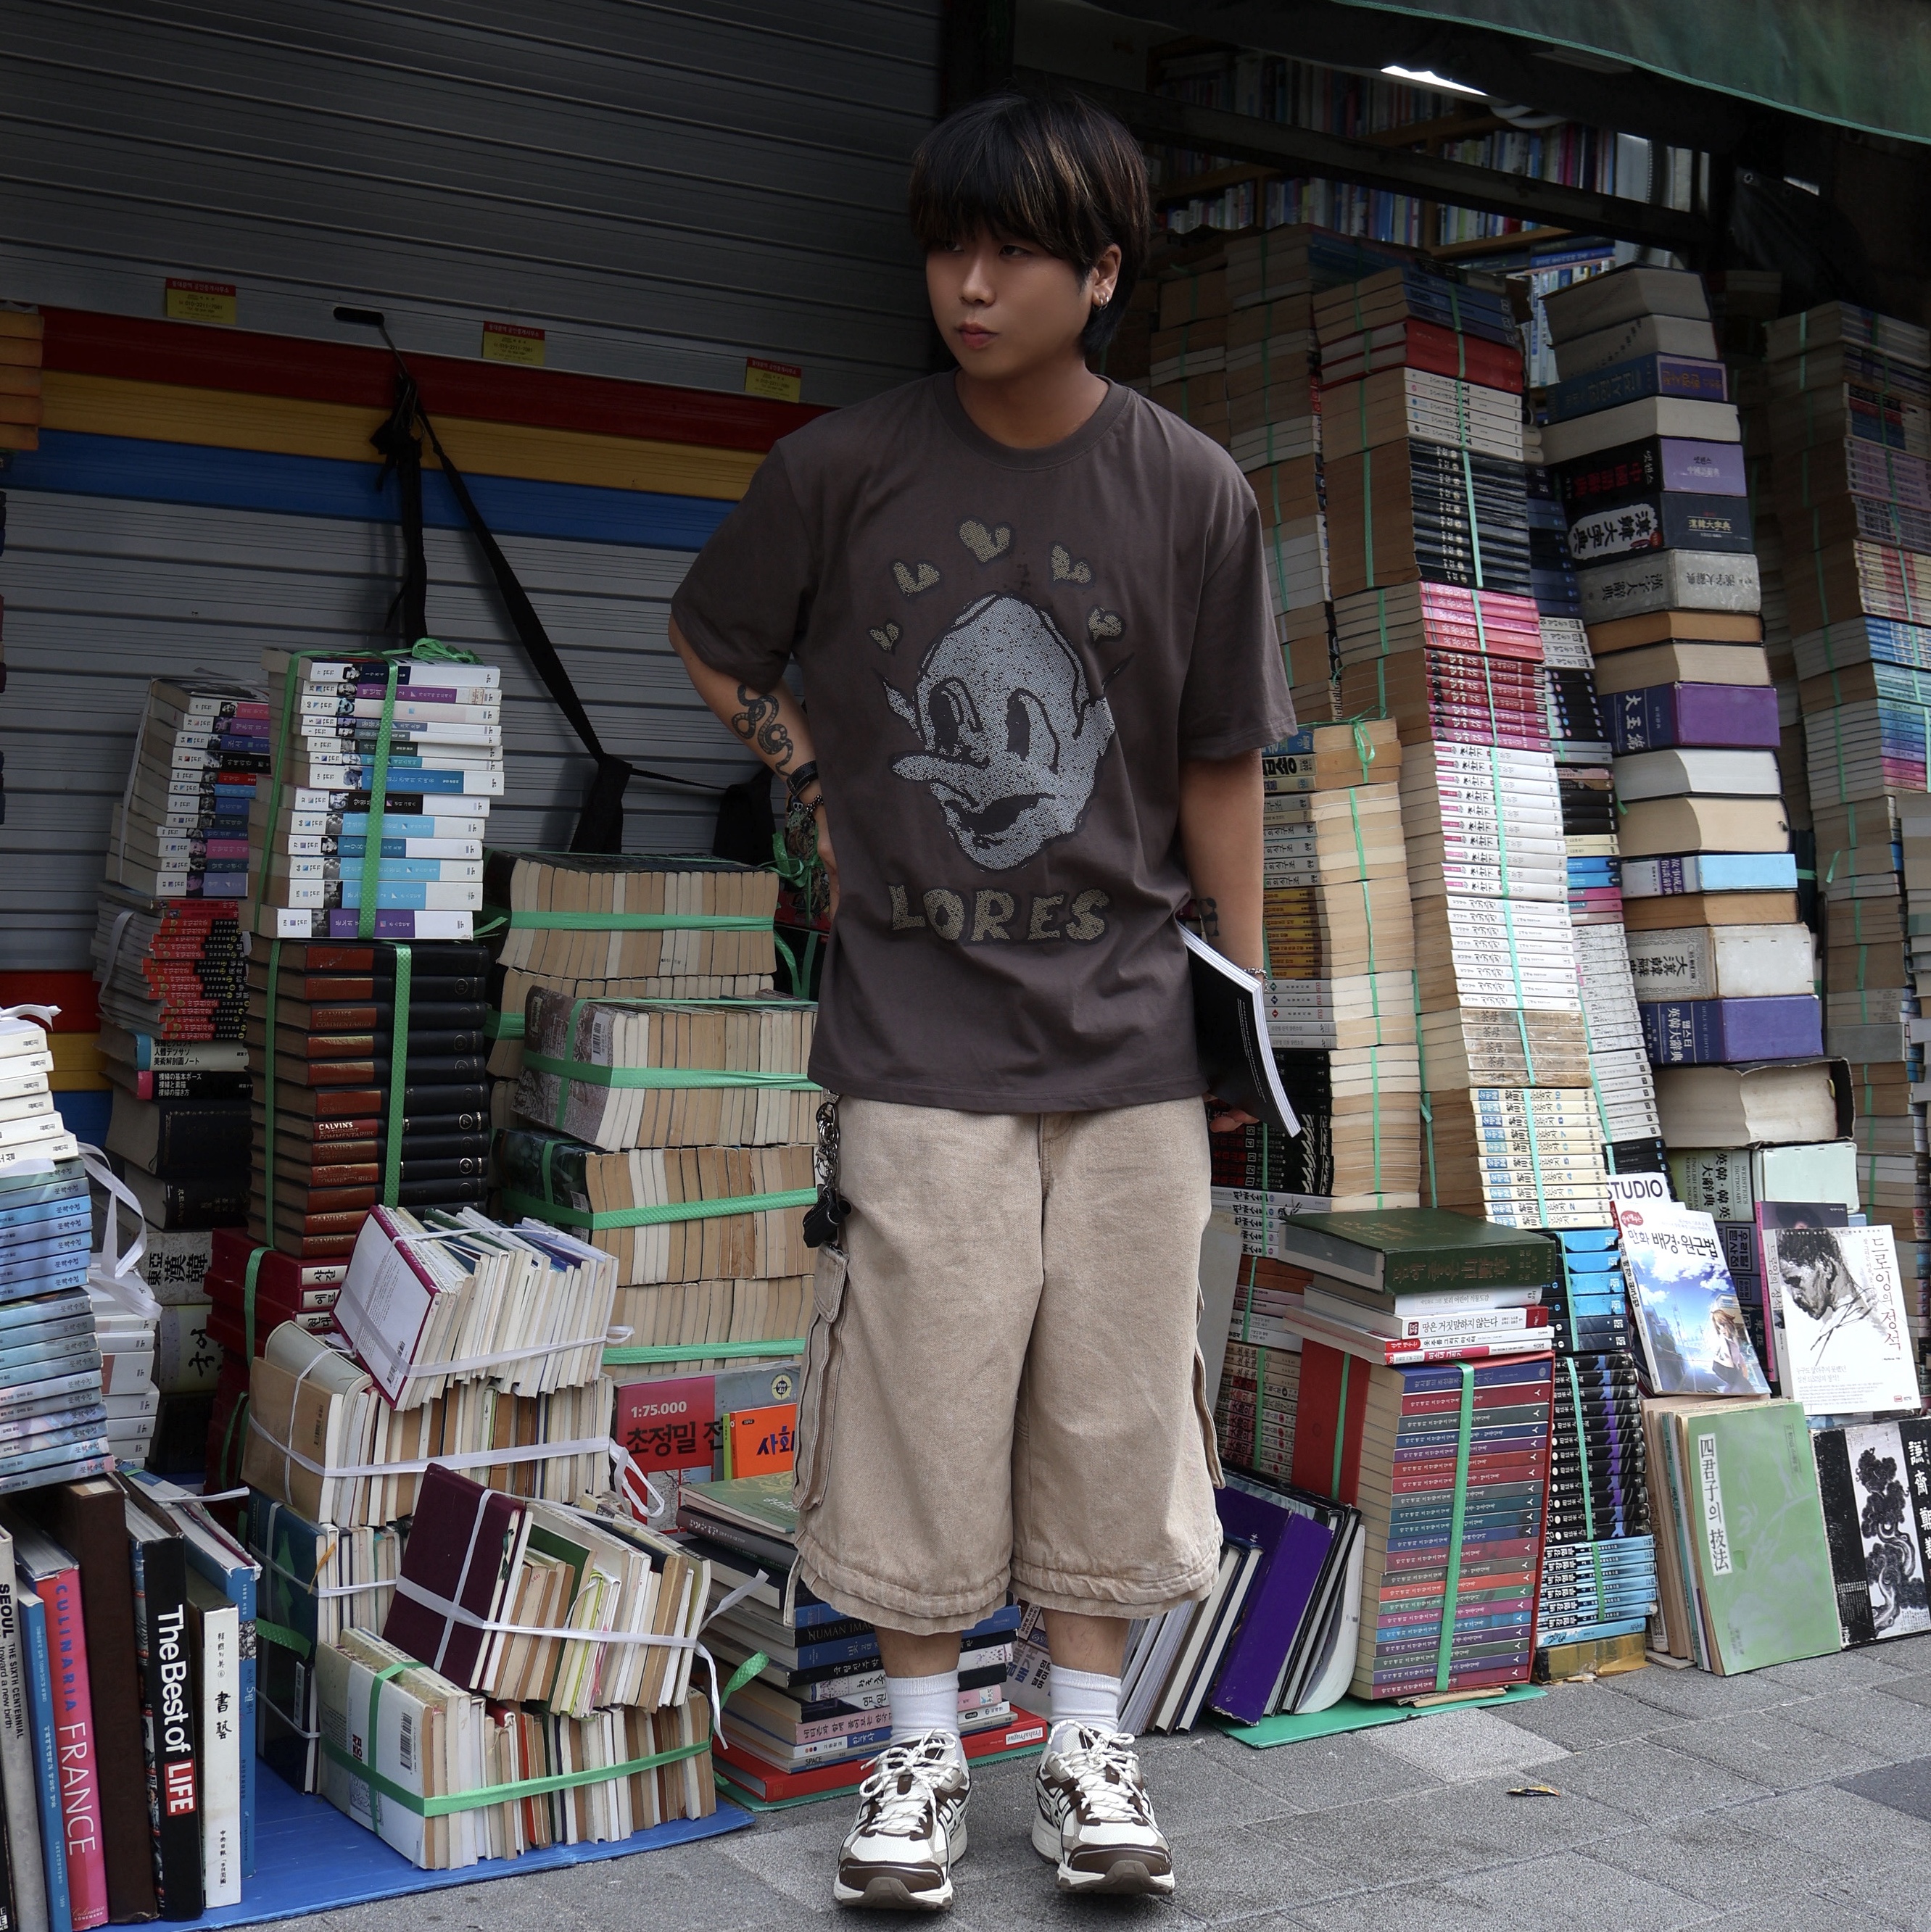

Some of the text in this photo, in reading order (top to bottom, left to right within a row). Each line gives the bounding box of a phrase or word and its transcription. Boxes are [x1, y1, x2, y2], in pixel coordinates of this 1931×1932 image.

[318, 1121, 353, 1131] CALVIN'S
[318, 1131, 374, 1140] COMMENTARIES
[1628, 1229, 1650, 1245] 만화
[1872, 1237, 1901, 1351] 드로잉의 정석
[1422, 1316, 1498, 1334] 땅은 거짓말하지 않는다
[627, 1421, 697, 1456] 초정밀
[1700, 1438, 1729, 1572] 四君子의 技法
[0, 1583, 15, 1638] SEOUL
[56, 1585, 76, 1712] CULINARIA
[9, 1660, 20, 1685] SIXTH
[158, 1604, 191, 1754] The Best of
[4, 1707, 13, 1729] birth
[12, 1686, 24, 1740] CENTENNIAL
[805, 1757, 822, 1766] SPACE
[59, 1721, 96, 1856] FRANCE
[168, 1762, 193, 1813] LIFE
